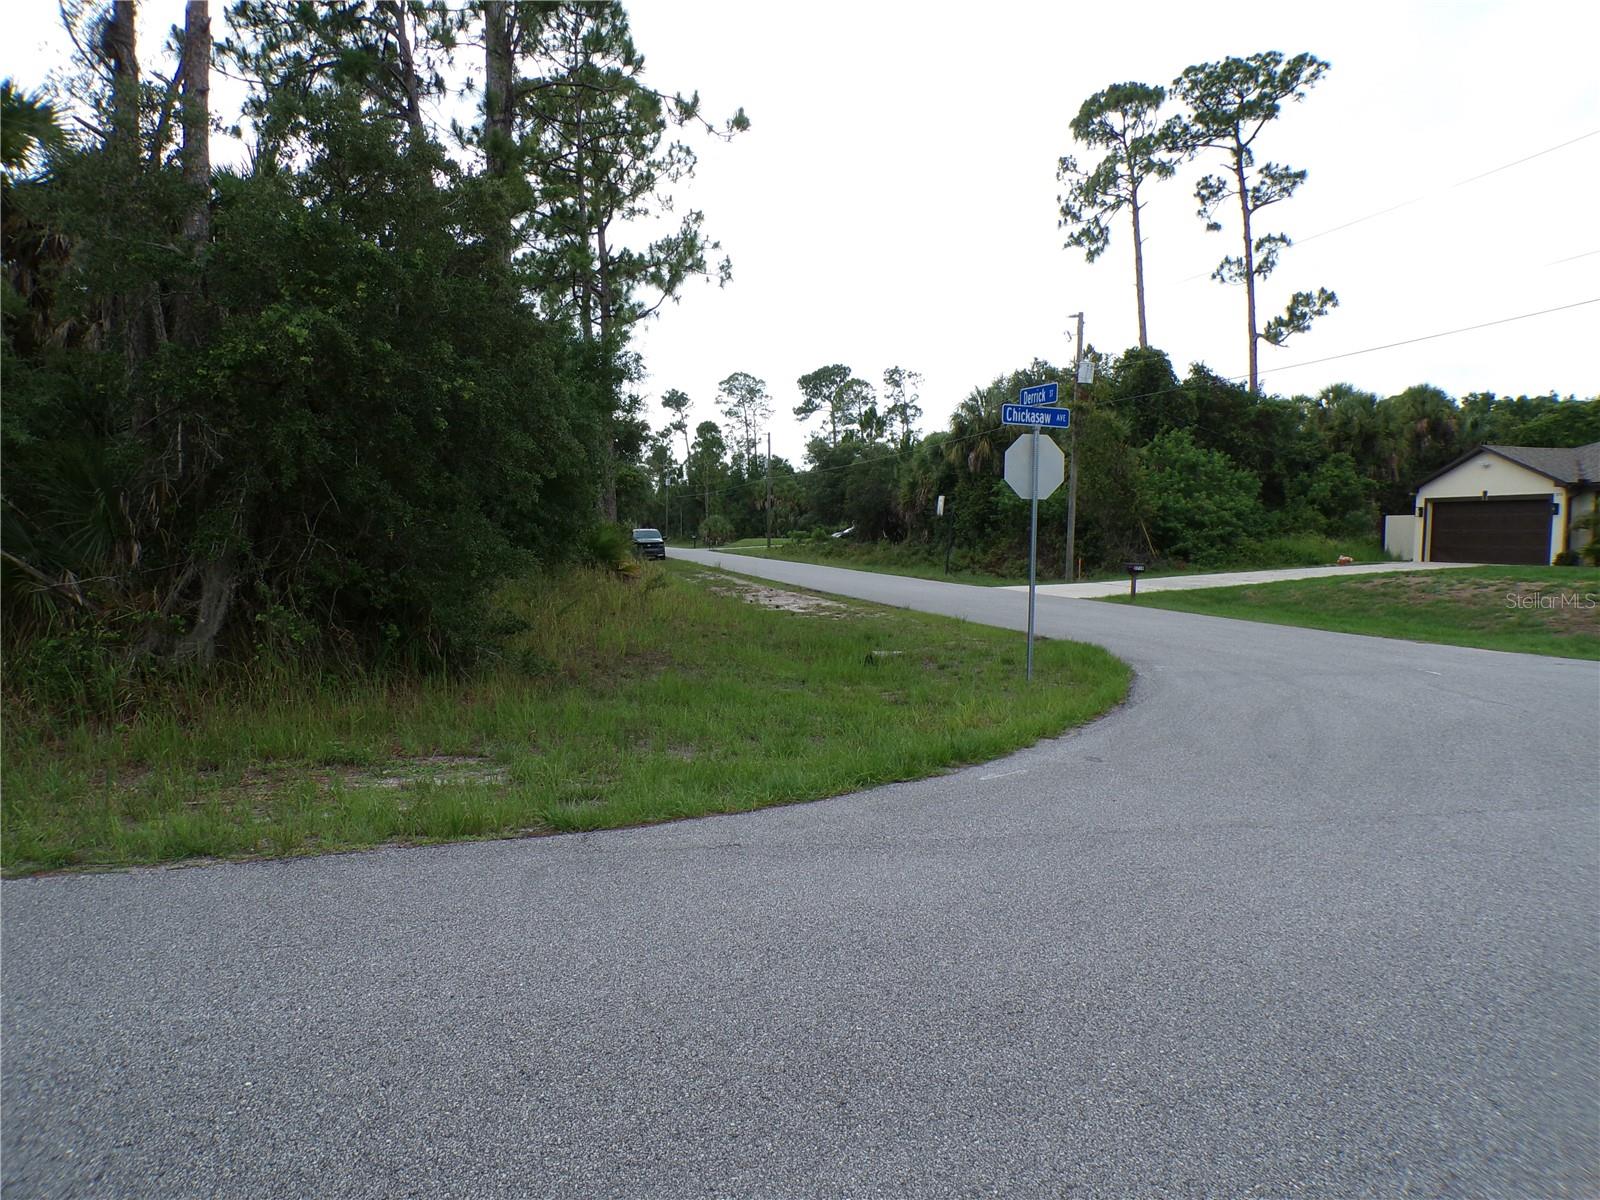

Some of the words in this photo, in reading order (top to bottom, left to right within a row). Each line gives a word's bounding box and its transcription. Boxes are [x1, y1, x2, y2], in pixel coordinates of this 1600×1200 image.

[1023, 388, 1046, 405] Derrick
[1006, 407, 1051, 424] Chickasaw
[1056, 413, 1067, 422] AVE
